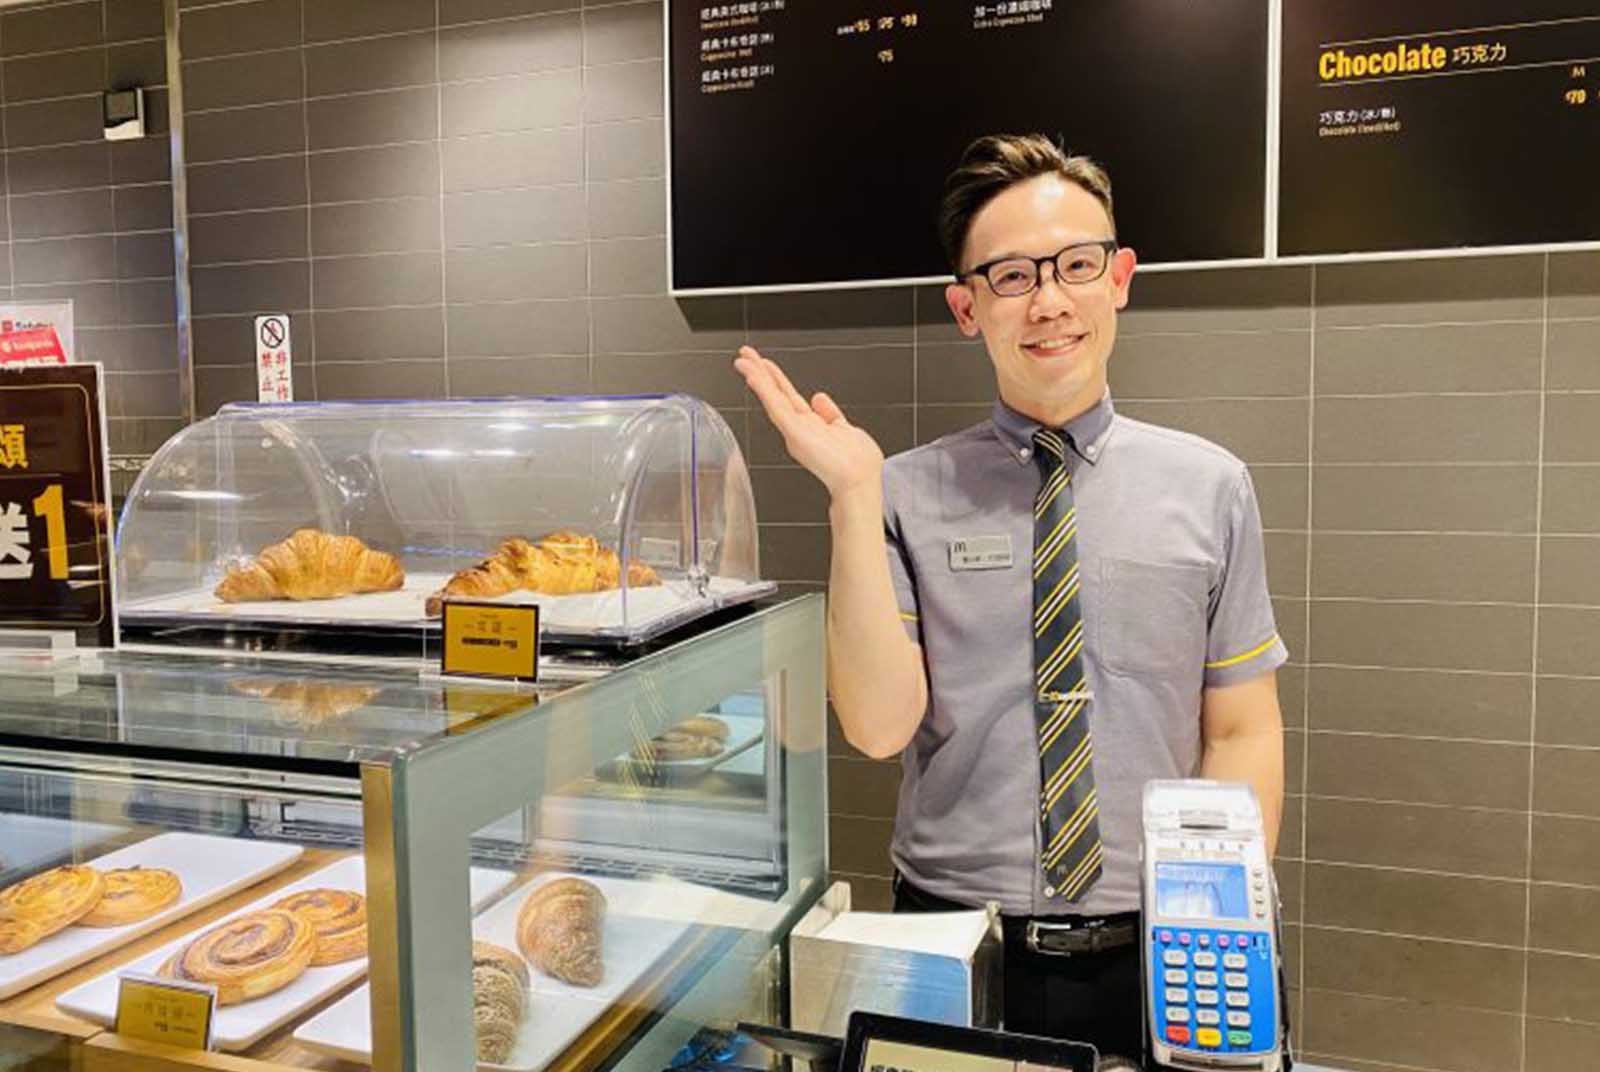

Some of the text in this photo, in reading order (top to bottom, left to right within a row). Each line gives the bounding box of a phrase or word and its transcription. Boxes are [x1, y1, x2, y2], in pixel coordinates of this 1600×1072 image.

[1319, 43, 1446, 80] Chocolate
[1452, 42, 1506, 65] 巧克力
